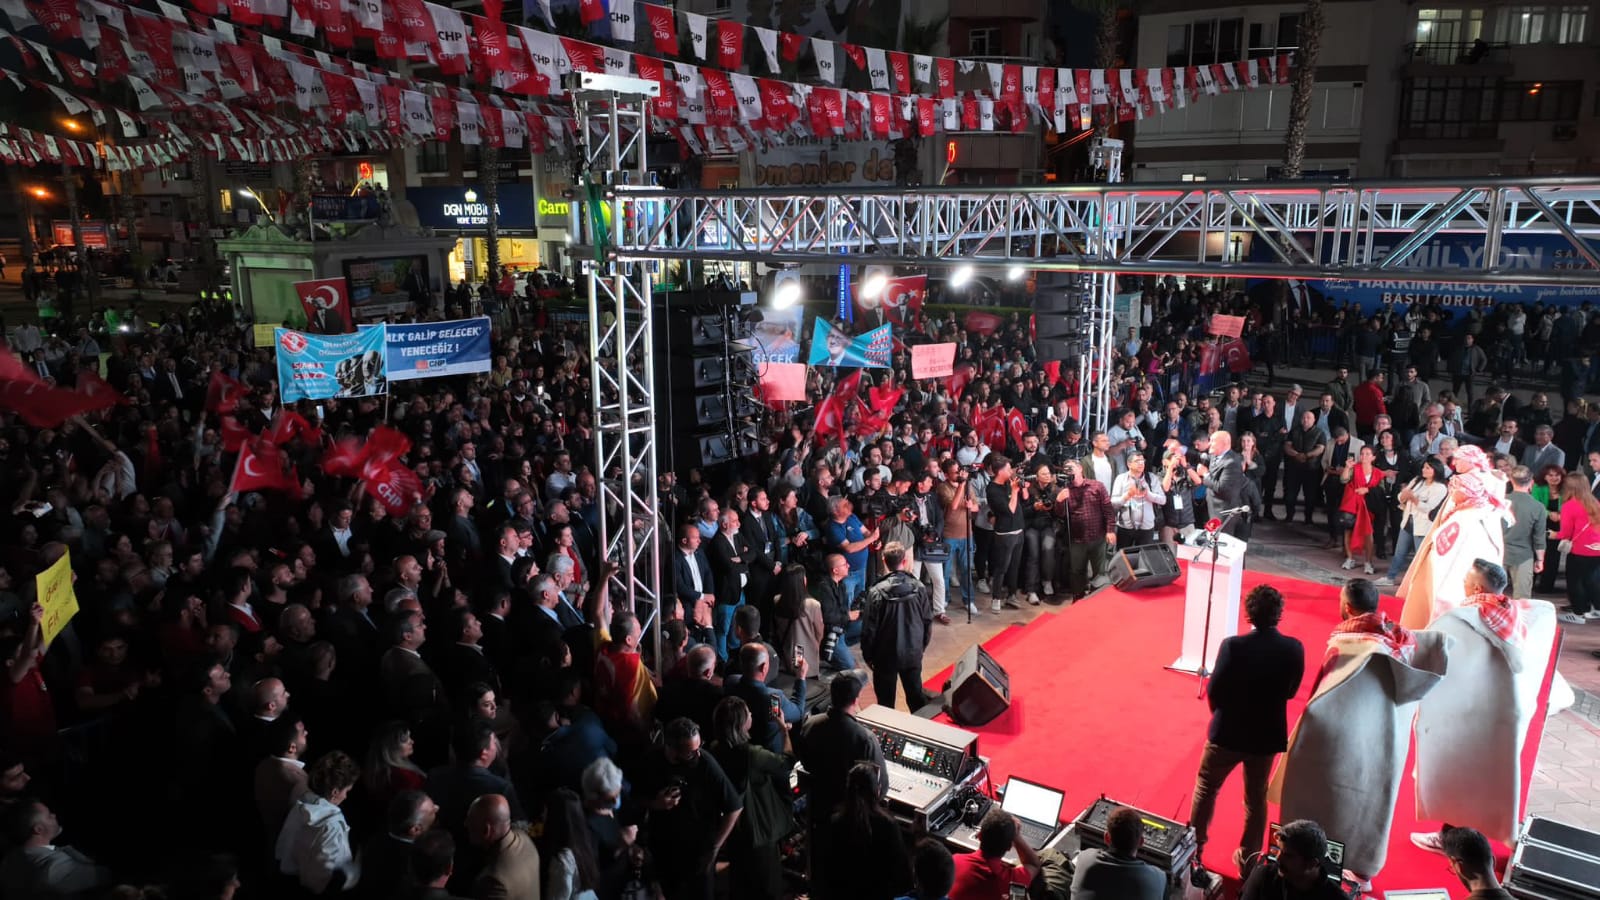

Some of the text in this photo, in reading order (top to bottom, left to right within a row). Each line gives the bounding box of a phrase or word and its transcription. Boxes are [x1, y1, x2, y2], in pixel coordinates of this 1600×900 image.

[610, 12, 630, 24] CHP
[438, 30, 462, 42] CHP
[533, 53, 550, 66] CHP
[605, 57, 624, 70] CHP
[443, 203, 463, 216] DGN
[408, 329, 437, 342] GALİP
[400, 342, 453, 357] YENECEĞİZ
[377, 482, 403, 507] CHP
